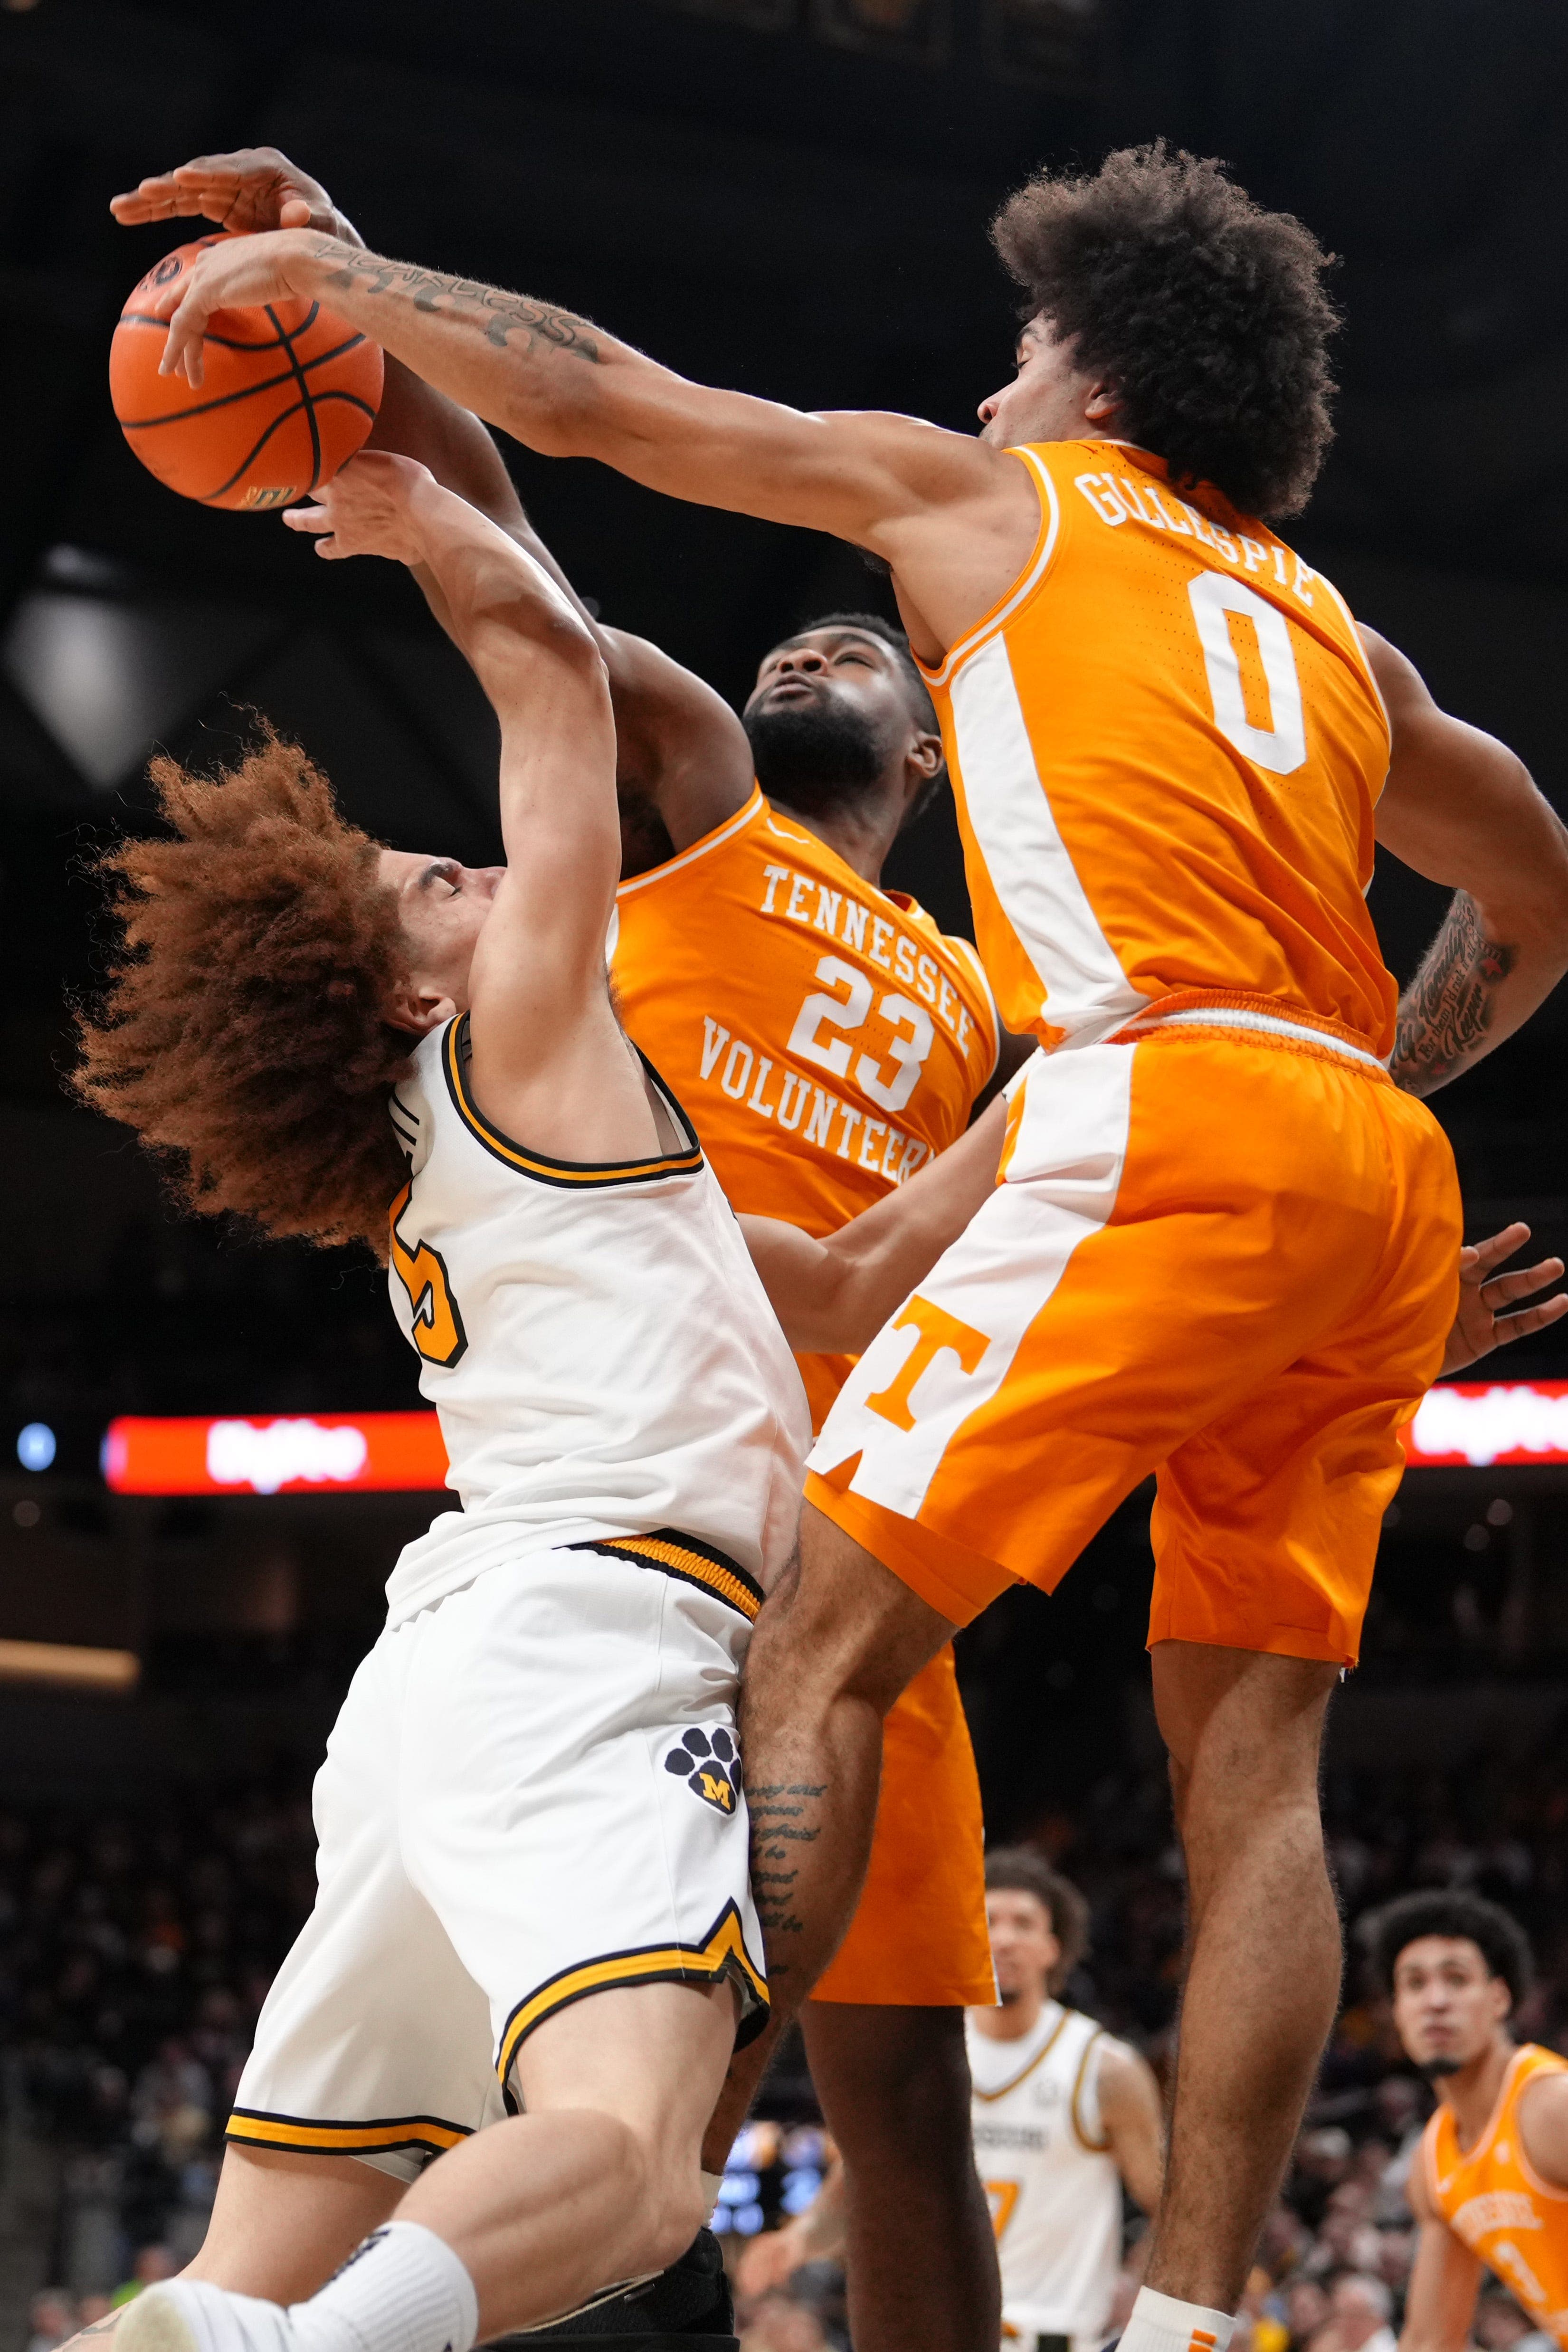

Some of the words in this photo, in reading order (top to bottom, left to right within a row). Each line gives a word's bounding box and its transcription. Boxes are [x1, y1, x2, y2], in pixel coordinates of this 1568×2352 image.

[1074, 472, 1314, 608] GILLESPIE
[1187, 570, 1306, 775] 0
[760, 864, 975, 1059] TENNESSEE
[786, 955, 935, 1113] 23
[699, 1015, 935, 1184] VOLUNTEER
[864, 1293, 991, 1433] T
[699, 1772, 731, 1810] M
